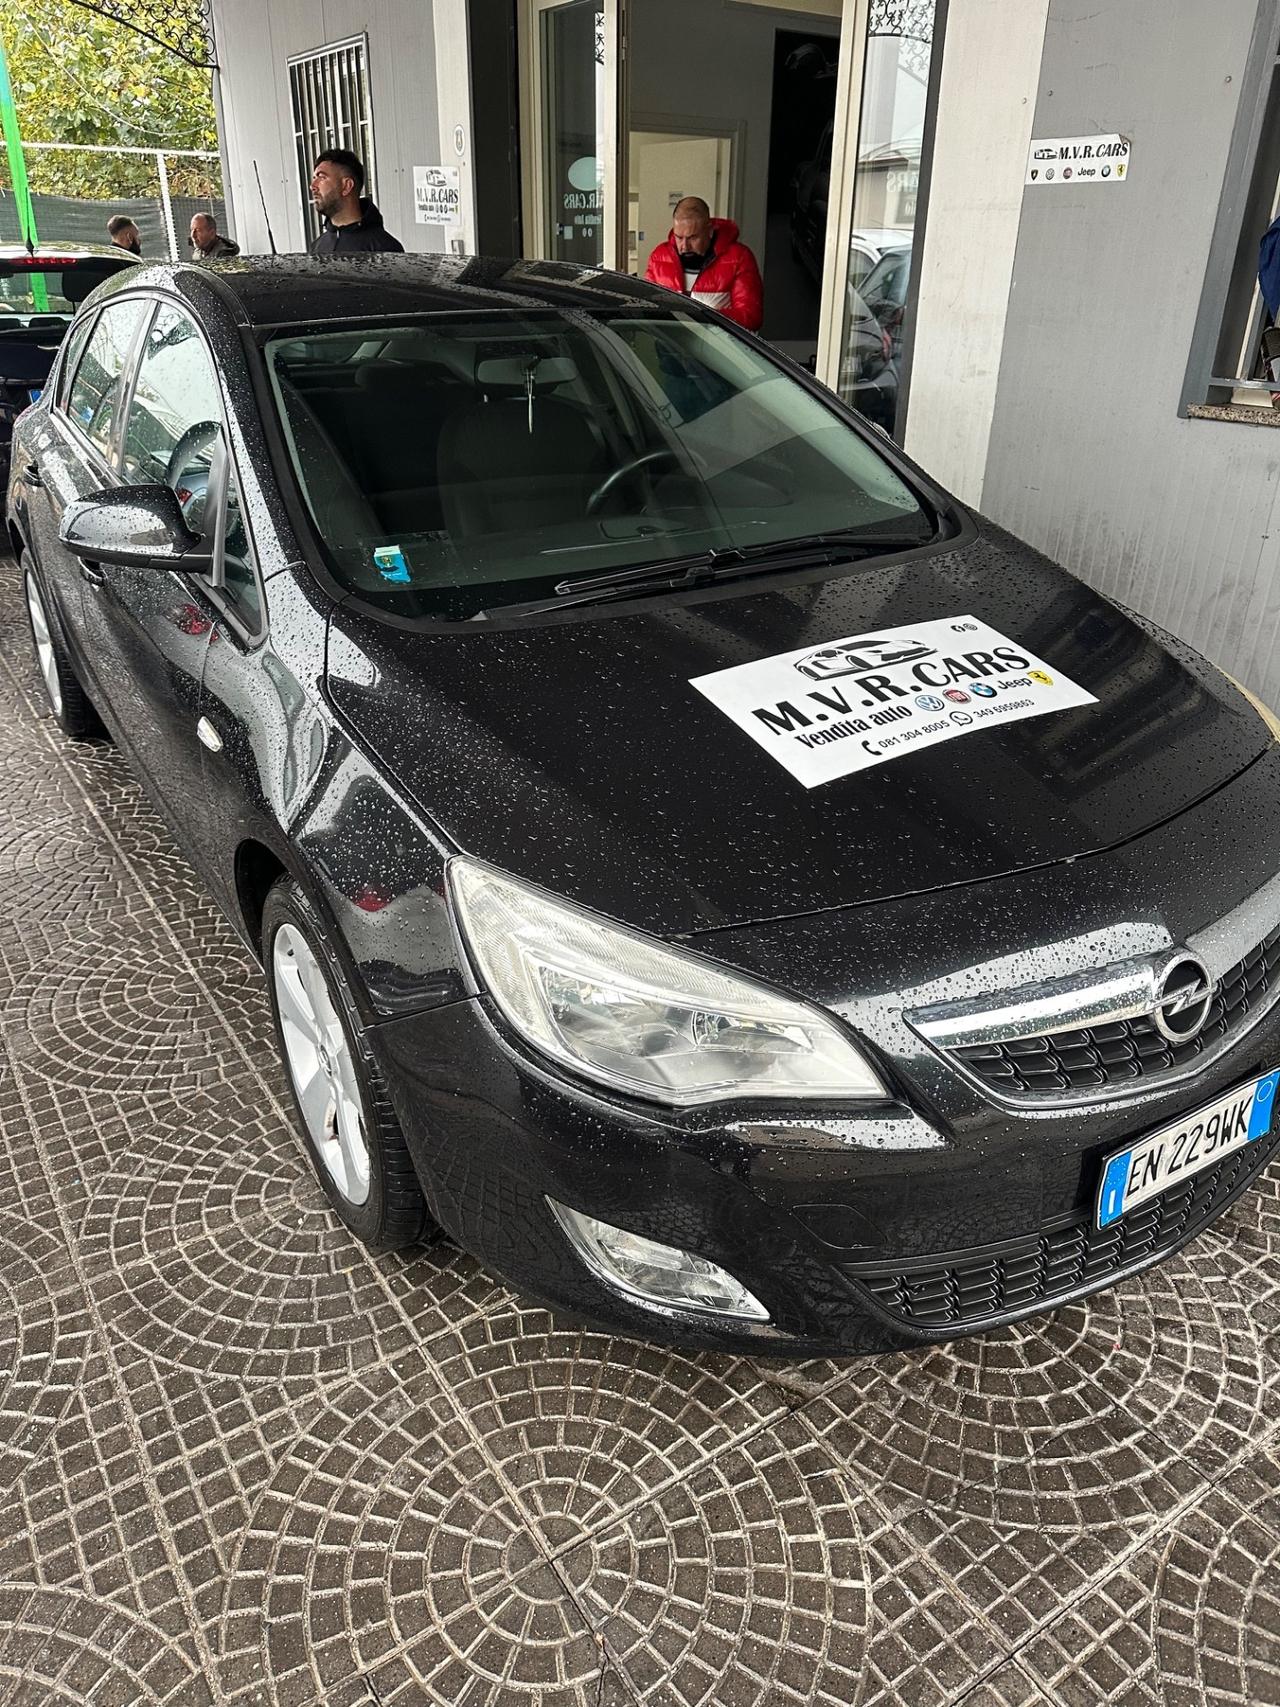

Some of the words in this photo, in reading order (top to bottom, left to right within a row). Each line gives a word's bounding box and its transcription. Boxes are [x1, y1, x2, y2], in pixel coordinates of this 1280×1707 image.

[1059, 143, 1129, 160] M.V.R.CARS
[751, 647, 1031, 736] M.V.R.CARS
[997, 678, 1033, 690] Jeep
[973, 708, 994, 718] 349
[794, 718, 872, 749] Vendita
[868, 706, 913, 726] auto
[878, 736, 901, 748] 081
[900, 729, 923, 741] 304
[922, 720, 950, 733] 8005
[1126, 1144, 1164, 1198] EN
